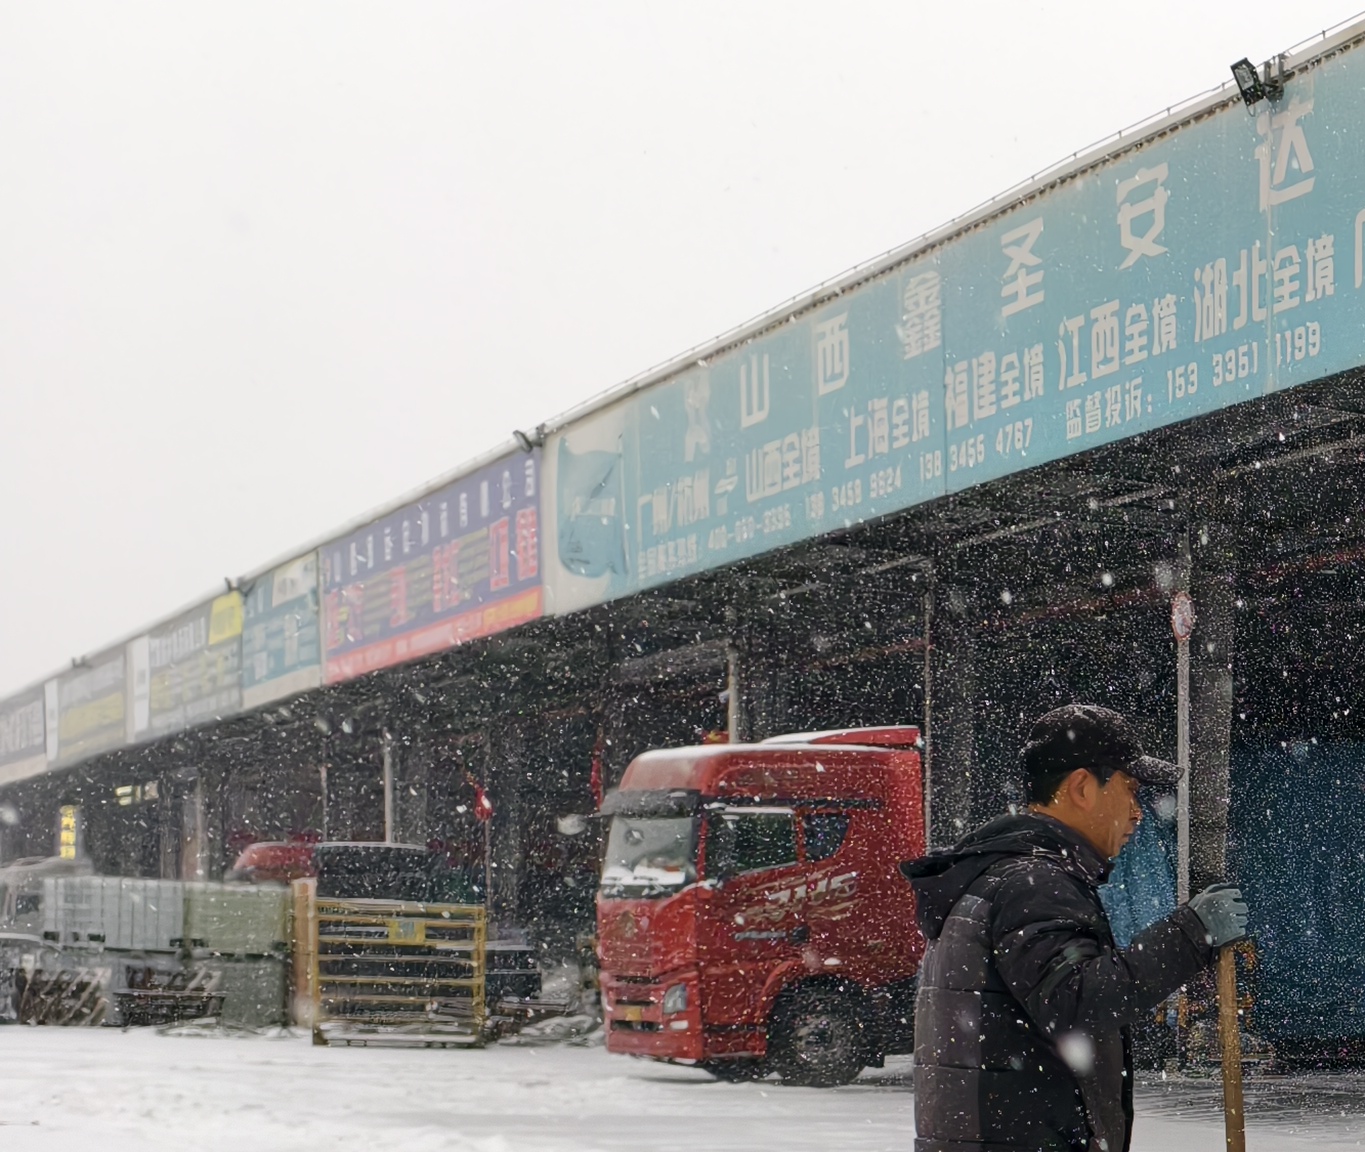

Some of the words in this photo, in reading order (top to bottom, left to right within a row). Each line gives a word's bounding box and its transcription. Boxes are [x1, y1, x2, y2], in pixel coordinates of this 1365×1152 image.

[745, 427, 820, 502] 山西全境
[844, 389, 930, 470] 上海全境
[943, 342, 1044, 431] 福建全境
[1057, 294, 1177, 391] 江西全境
[1193, 232, 1335, 343] 湖北全境
[1167, 362, 1198, 402] 153
[1212, 342, 1259, 387] 3351
[1275, 321, 1321, 367] 1199
